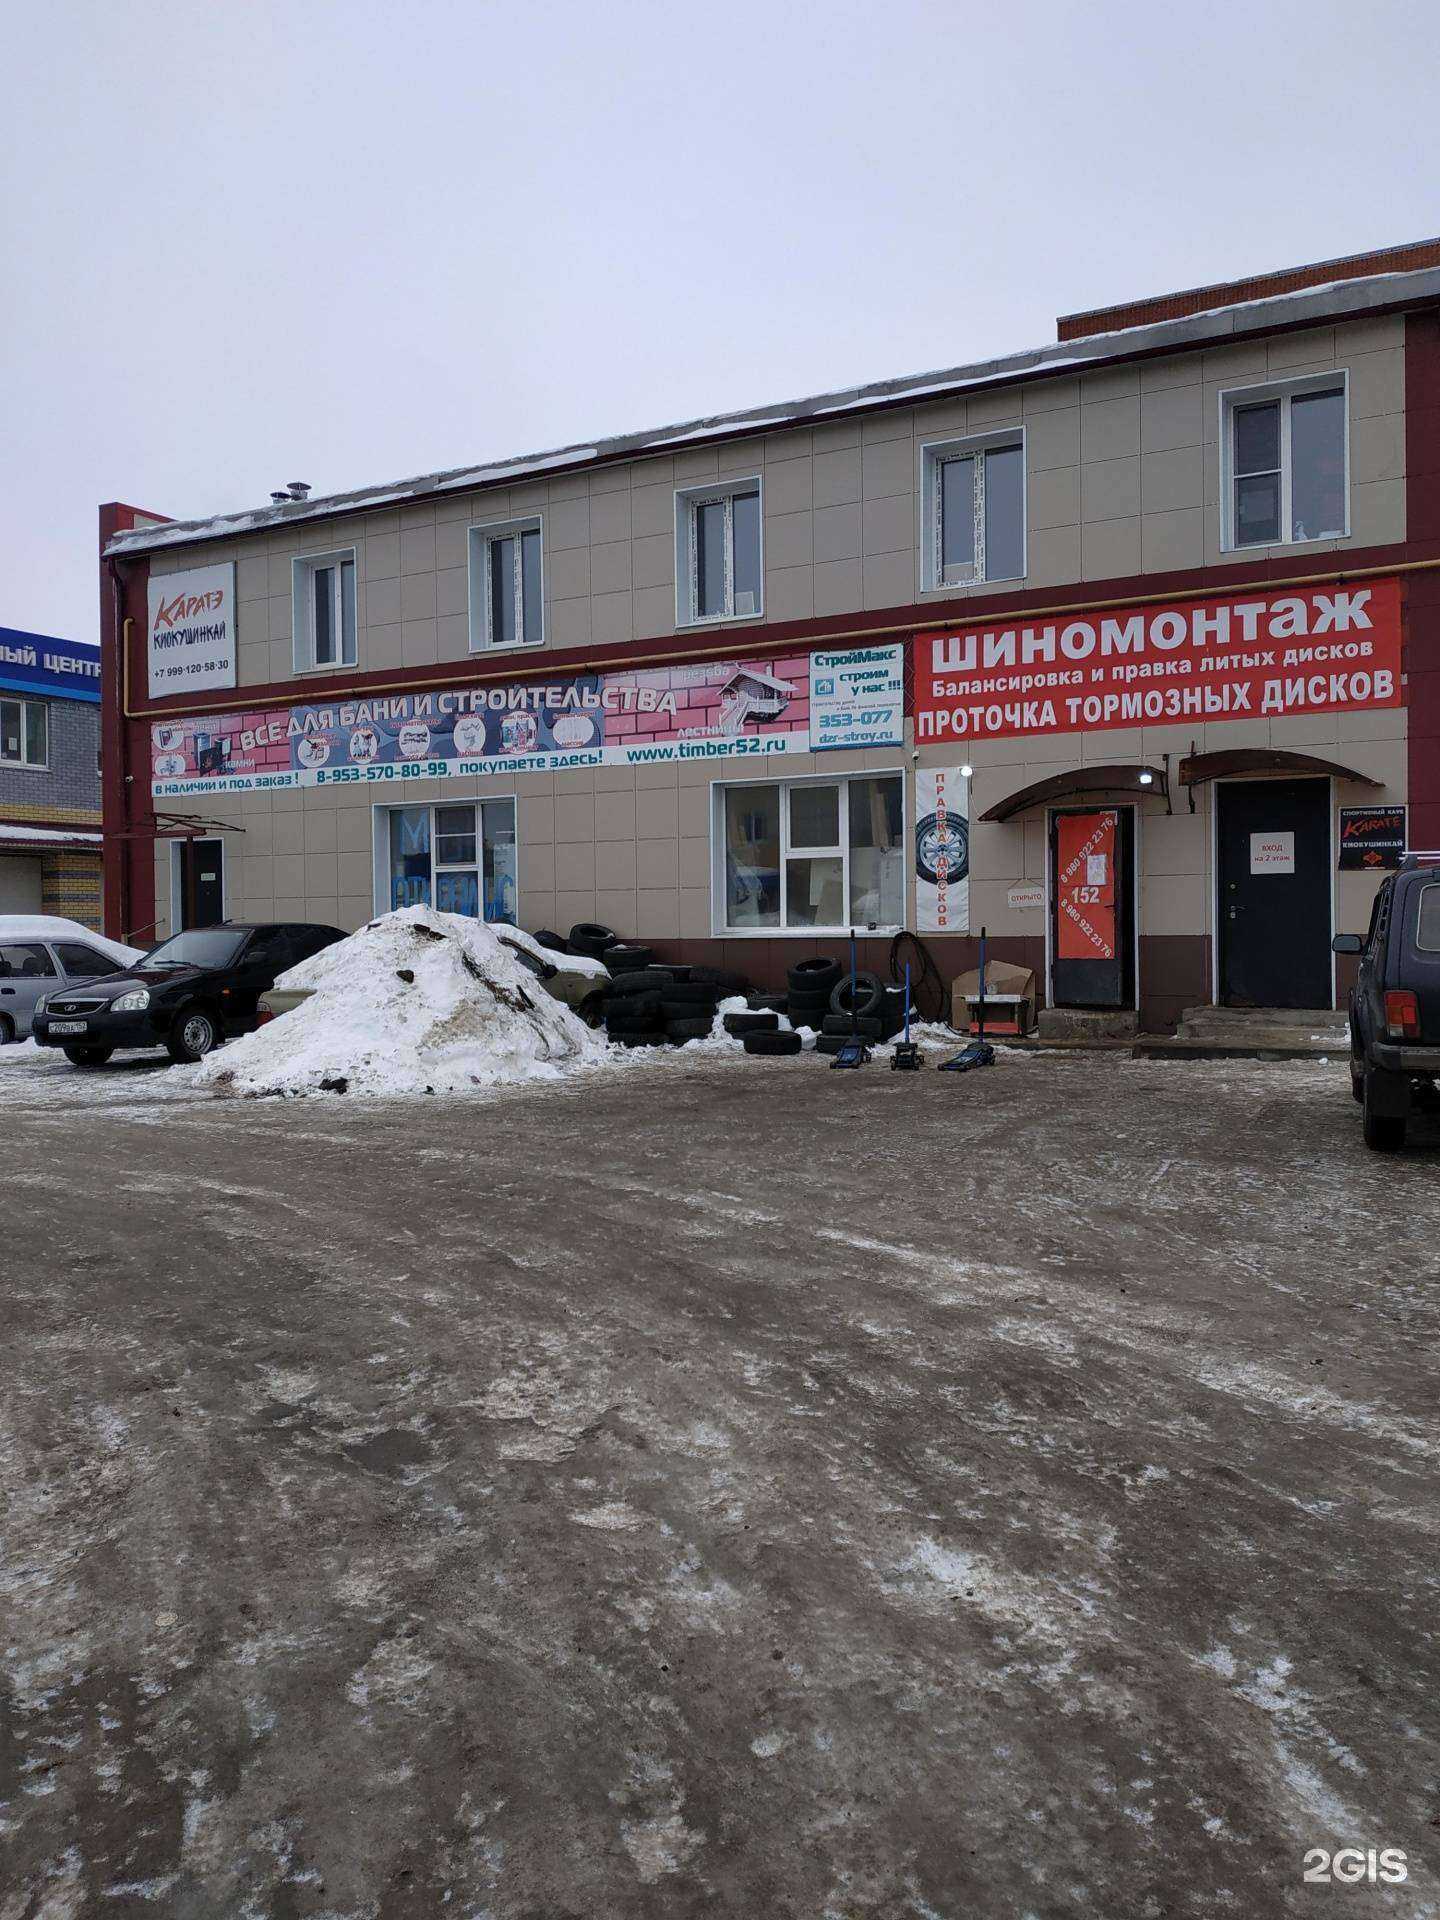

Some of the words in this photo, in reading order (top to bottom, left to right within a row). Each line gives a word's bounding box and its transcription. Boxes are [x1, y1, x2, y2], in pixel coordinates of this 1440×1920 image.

[153, 621, 226, 650] КИОКУШИНКАЙ
[815, 649, 897, 668] СтройМакс
[932, 669, 1083, 697] Балансировка
[1091, 667, 1104, 681] и
[1112, 659, 1192, 683] правка
[1200, 651, 1275, 672] литых
[1283, 641, 1374, 667] дисков
[839, 669, 889, 682] строим
[851, 686, 860, 696] у
[862, 683, 886, 693] нас
[918, 700, 1057, 737] ПРОТОЧКА
[1066, 682, 1252, 724] ТОРМОЗНЫХ
[1261, 669, 1394, 714] ДИСКОВ
[239, 721, 283, 752] ВСЕ
[285, 708, 334, 738] ДЛЯ
[339, 697, 408, 727] БАНИ
[414, 695, 432, 716] И
[437, 685, 677, 716] СТРОИТЕЛЬСТВА
[819, 709, 893, 728] 353-077
[627, 737, 786, 763] www.timber52.ru
[819, 731, 893, 743] dzr-stroy.ru
[459, 756, 546, 776] покупаете
[549, 750, 603, 767] здесь!
[165, 779, 216, 794] наличии
[218, 779, 227, 789] и
[230, 777, 253, 789] под
[255, 774, 292, 786] заказ
[936, 773, 947, 843] ПРАВКА
[936, 857, 948, 926] ДИСКОВ
[1011, 893, 1042, 902] ОТКРЫТО
[1071, 886, 1100, 904] 152
[1066, 904, 1081, 922] 980
[1079, 918, 1094, 937] 922
[1091, 933, 1103, 947] 23
